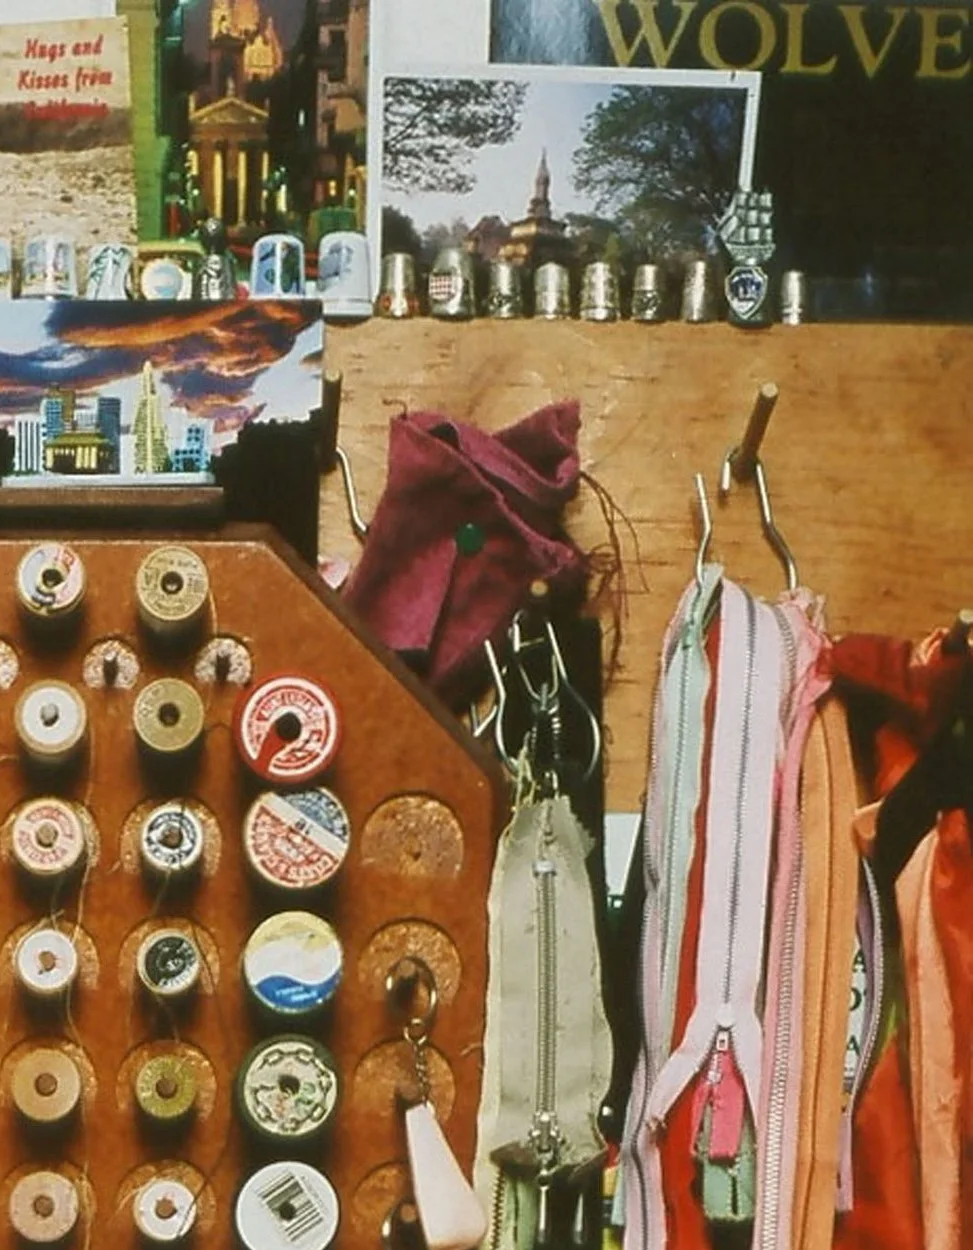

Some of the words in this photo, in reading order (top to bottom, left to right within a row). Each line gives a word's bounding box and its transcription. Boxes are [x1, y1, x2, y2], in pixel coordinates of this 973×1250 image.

[24, 37, 66, 63] Hugs
[72, 33, 104, 56] and
[18, 70, 68, 90] Kisses
